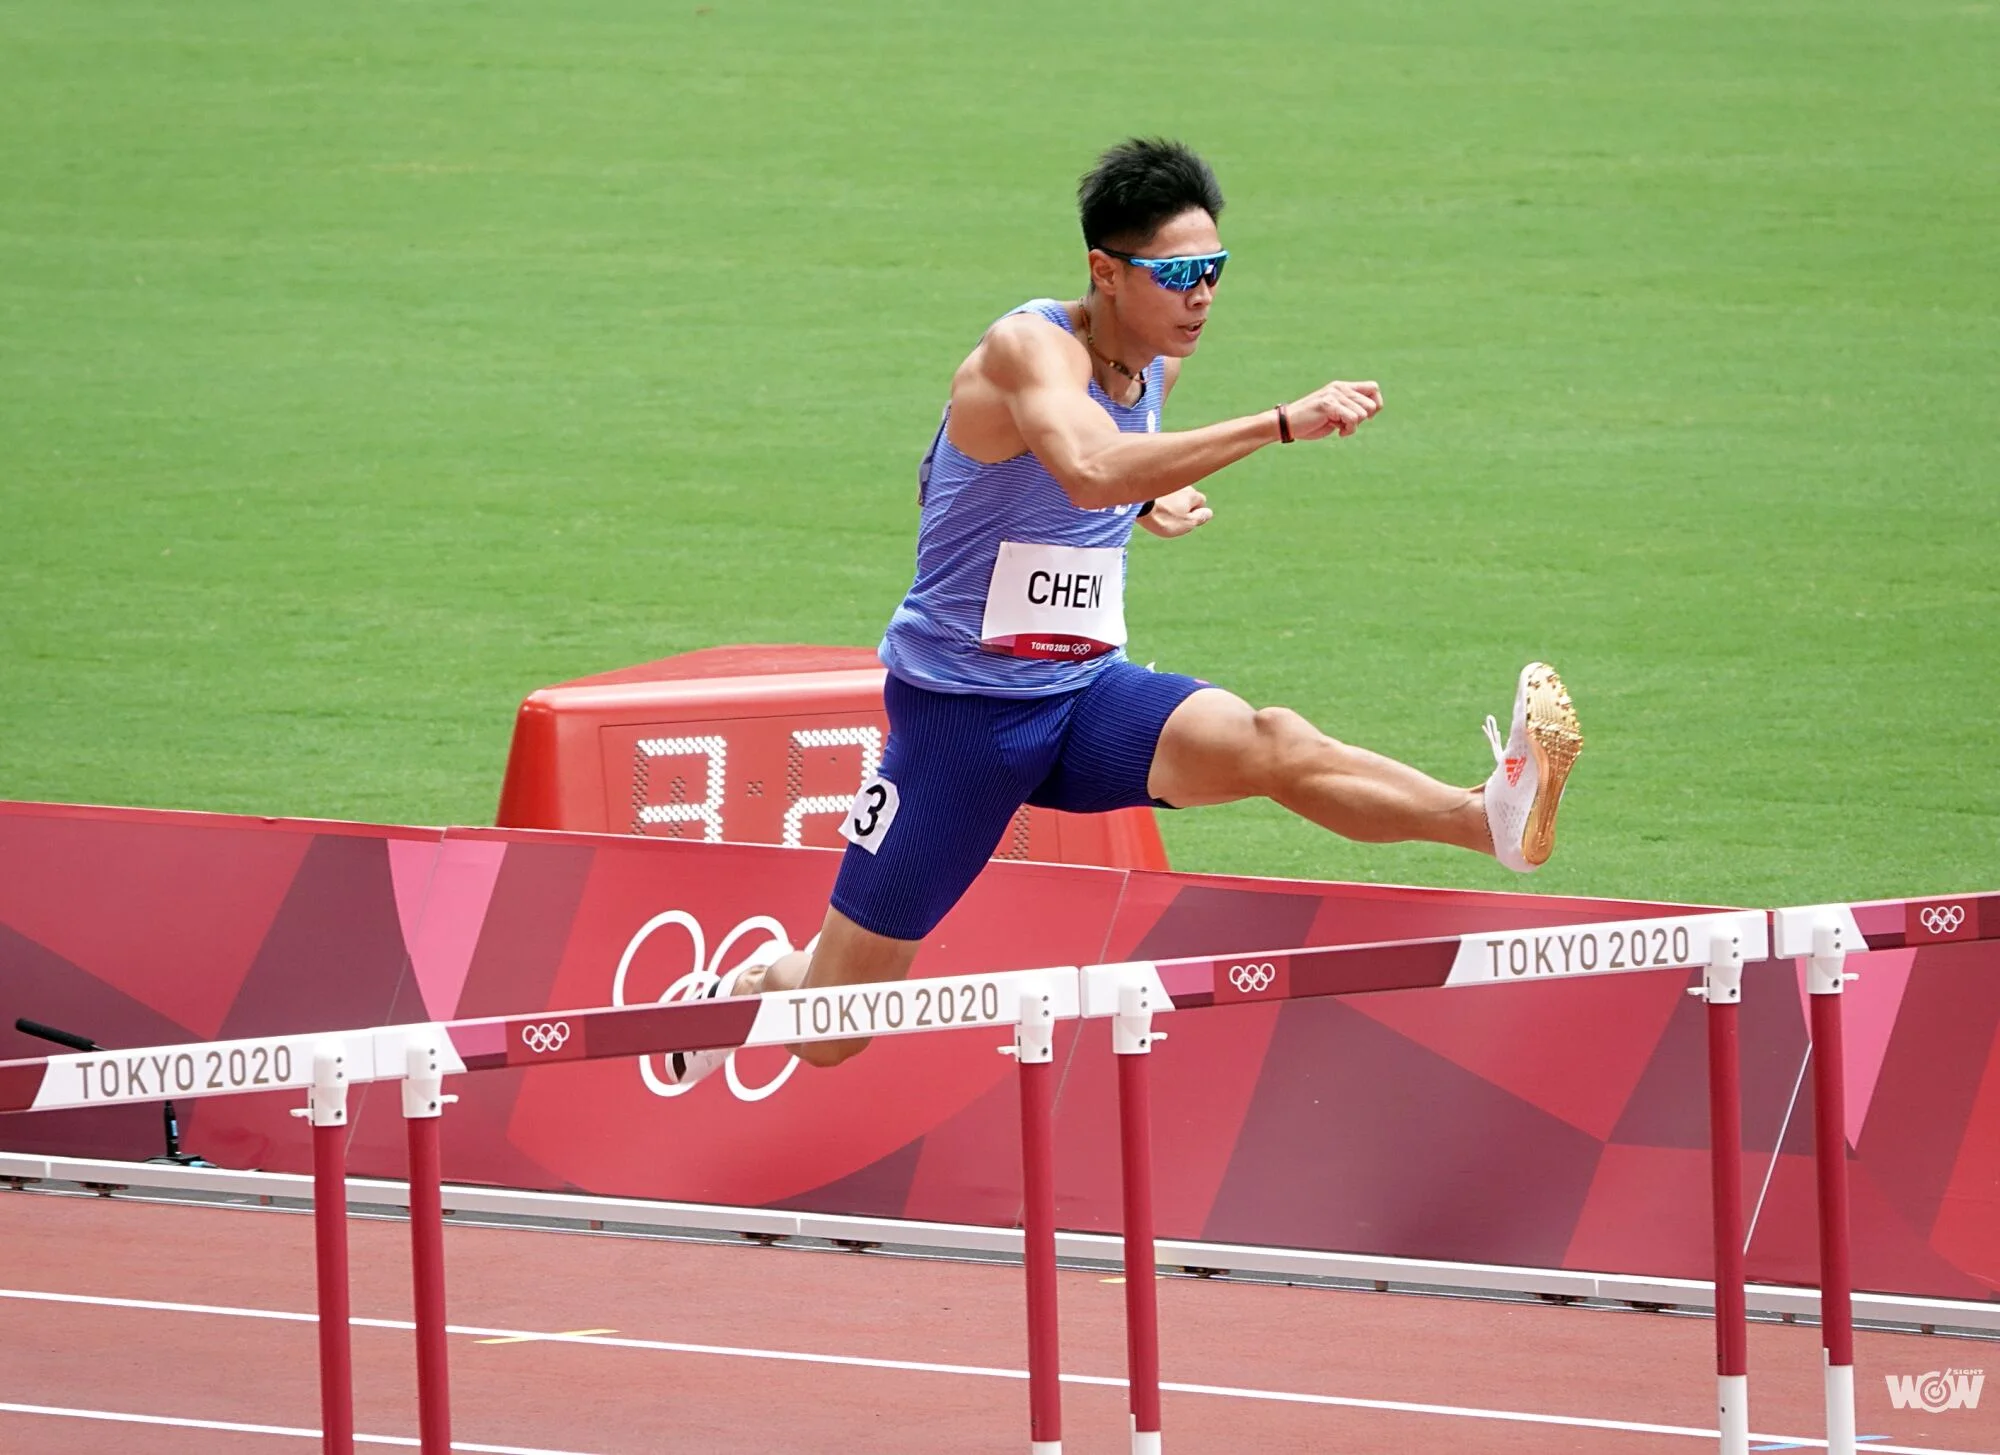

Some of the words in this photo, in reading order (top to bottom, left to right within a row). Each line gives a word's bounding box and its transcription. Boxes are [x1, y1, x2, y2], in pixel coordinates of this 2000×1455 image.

[1027, 570, 1103, 609] CHEN
[1031, 641, 1054, 652] TOKYO
[1054, 643, 1071, 653] 2020
[854, 784, 887, 837] 3
[1486, 932, 1598, 978] TOKYO
[1607, 925, 1690, 969] 2020
[788, 990, 905, 1036] TOKYO
[915, 982, 999, 1027] 2020
[75, 1053, 195, 1100] TOKYO
[206, 1044, 293, 1089] 2020
